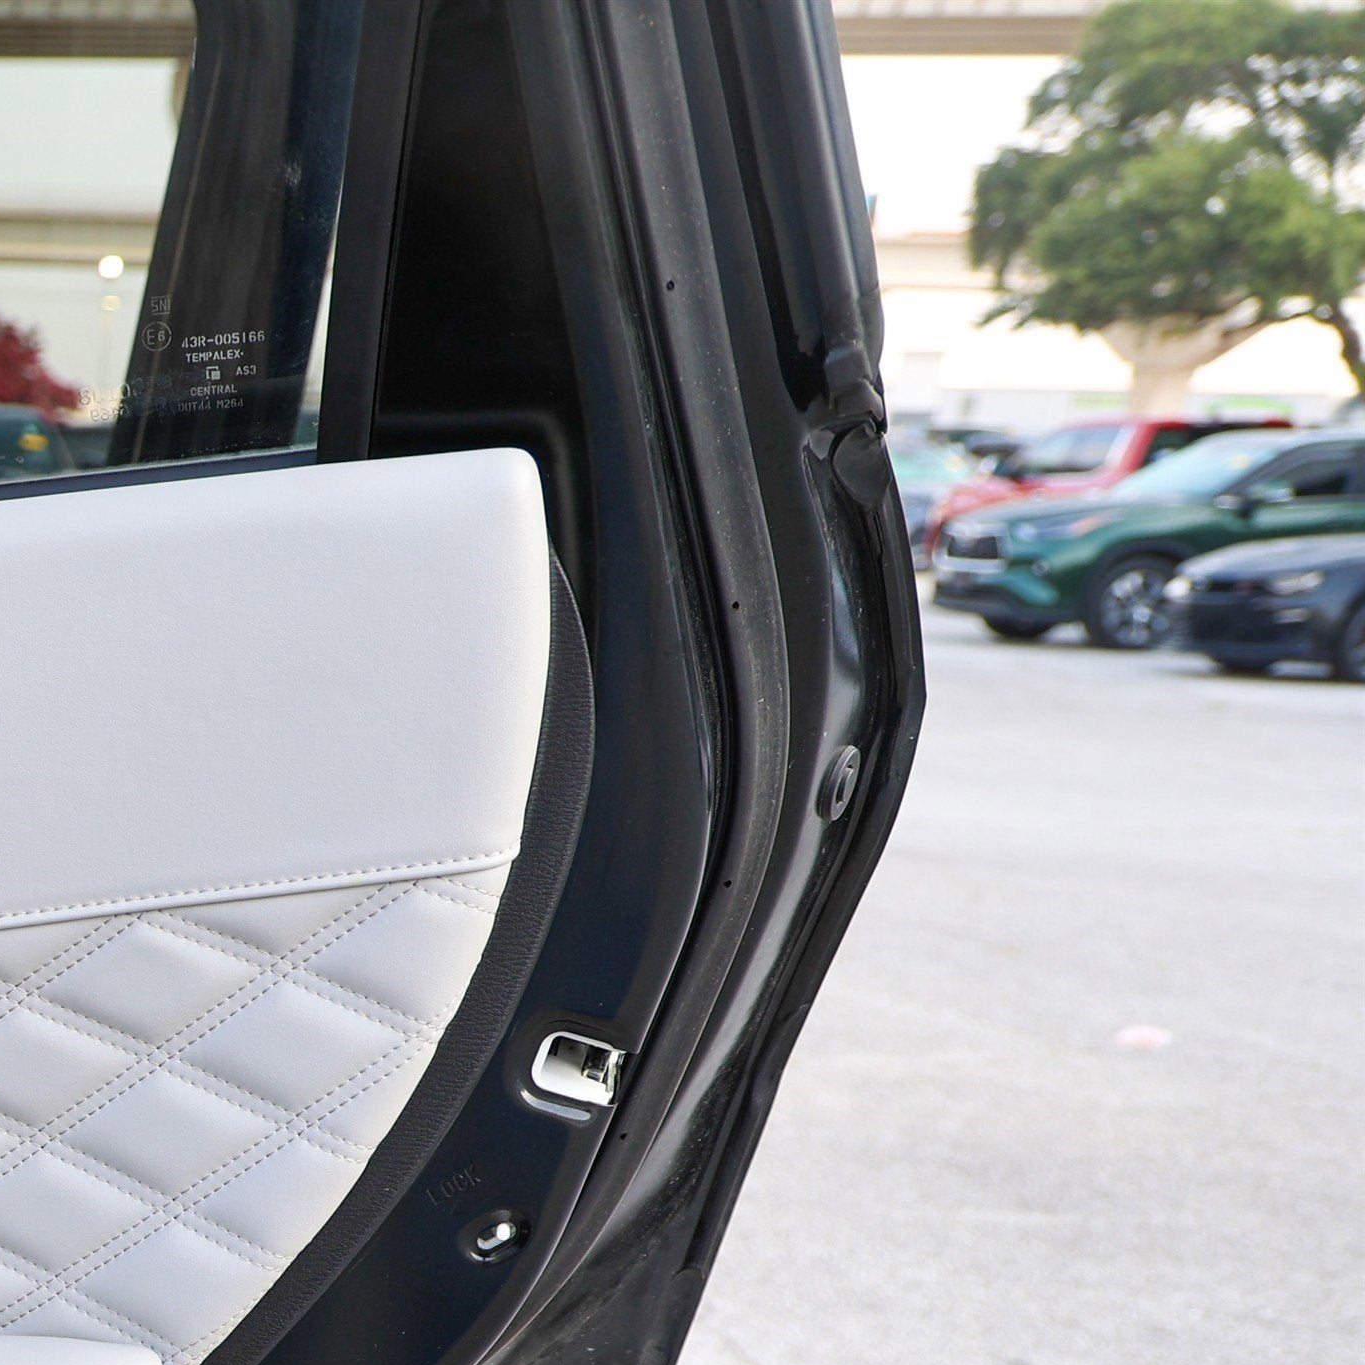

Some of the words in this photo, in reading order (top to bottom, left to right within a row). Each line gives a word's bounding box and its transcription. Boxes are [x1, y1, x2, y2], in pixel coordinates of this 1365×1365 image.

[150, 297, 171, 313] SNI
[181, 330, 266, 349] 43R-005166
[185, 349, 242, 363] TEMPALEX
[235, 365, 257, 376] AS3
[190, 383, 238, 398] CENTRAL
[426, 1163, 485, 1206] LOCK
